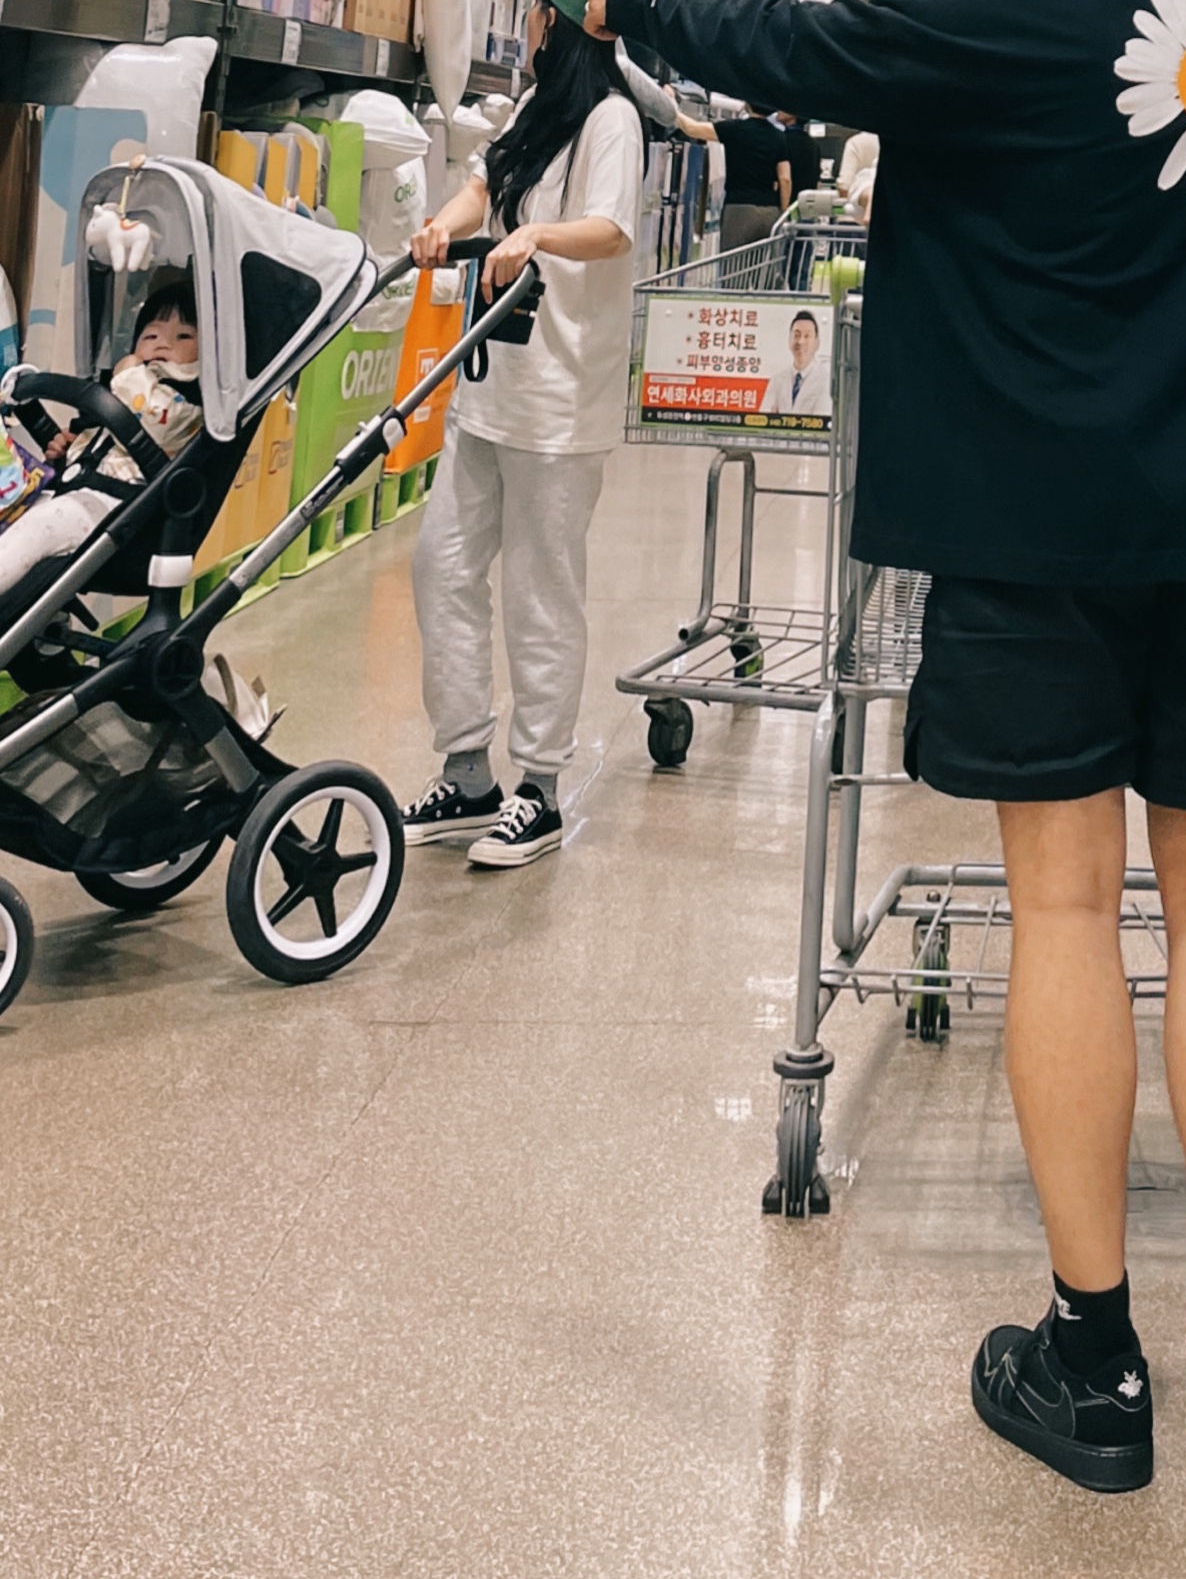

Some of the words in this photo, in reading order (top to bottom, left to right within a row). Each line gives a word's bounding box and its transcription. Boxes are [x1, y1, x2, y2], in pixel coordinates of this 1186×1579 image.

[698, 308, 759, 327] 화상치료
[696, 330, 757, 350] 흉터치료
[686, 354, 762, 373] 피부양성종양
